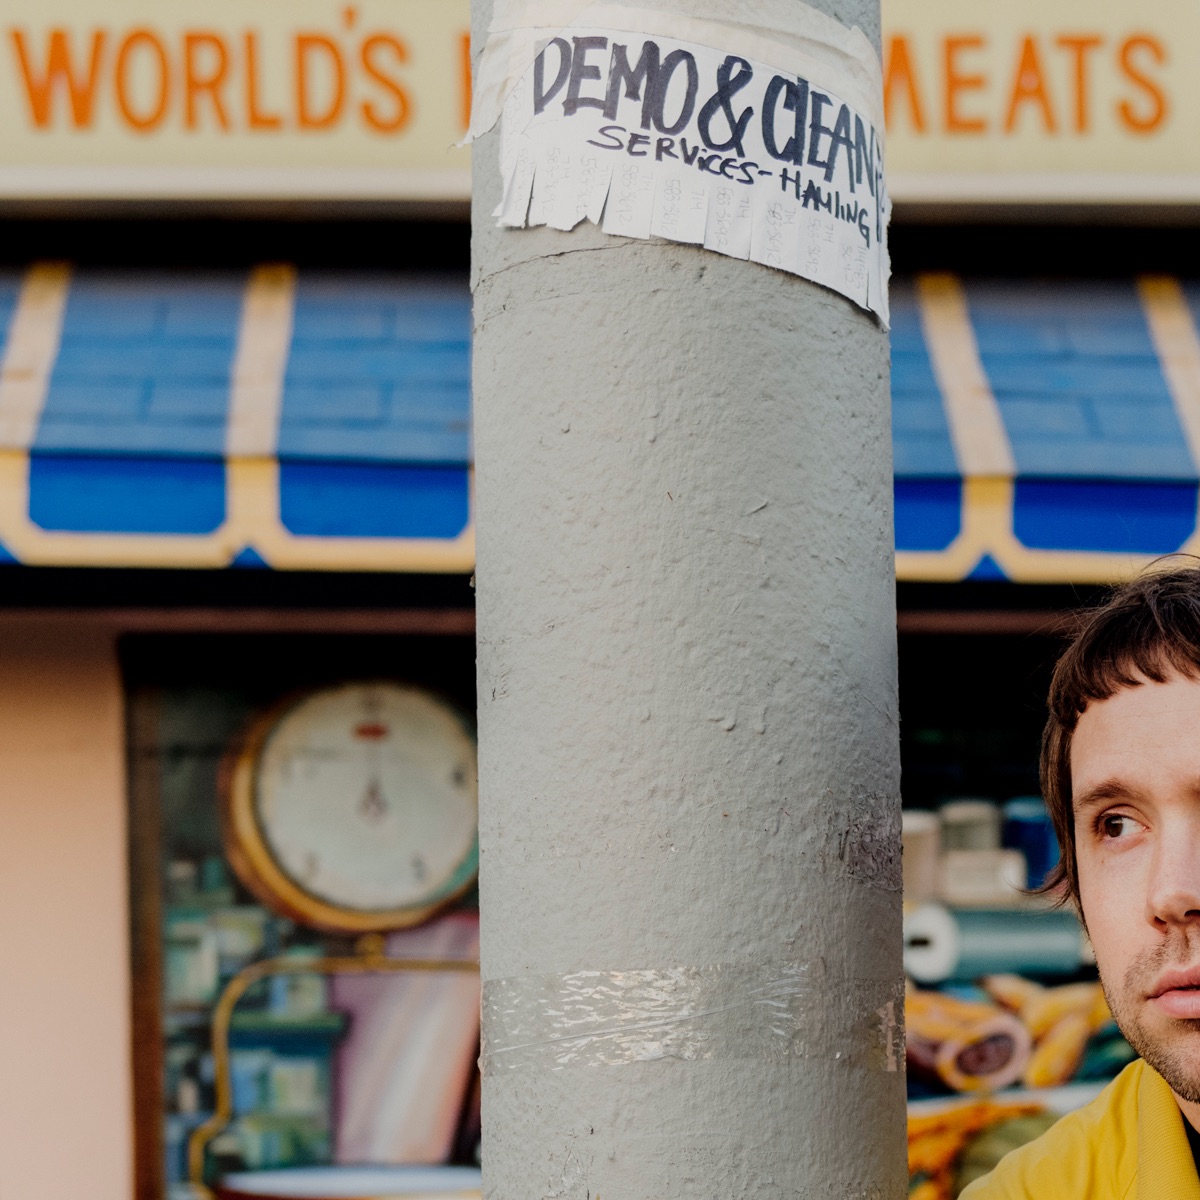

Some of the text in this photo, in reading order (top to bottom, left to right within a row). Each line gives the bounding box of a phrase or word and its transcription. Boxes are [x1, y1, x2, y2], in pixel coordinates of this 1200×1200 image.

[8, 5, 413, 136] WORLD'S
[533, 36, 698, 136] DEMO
[698, 55, 753, 159] &
